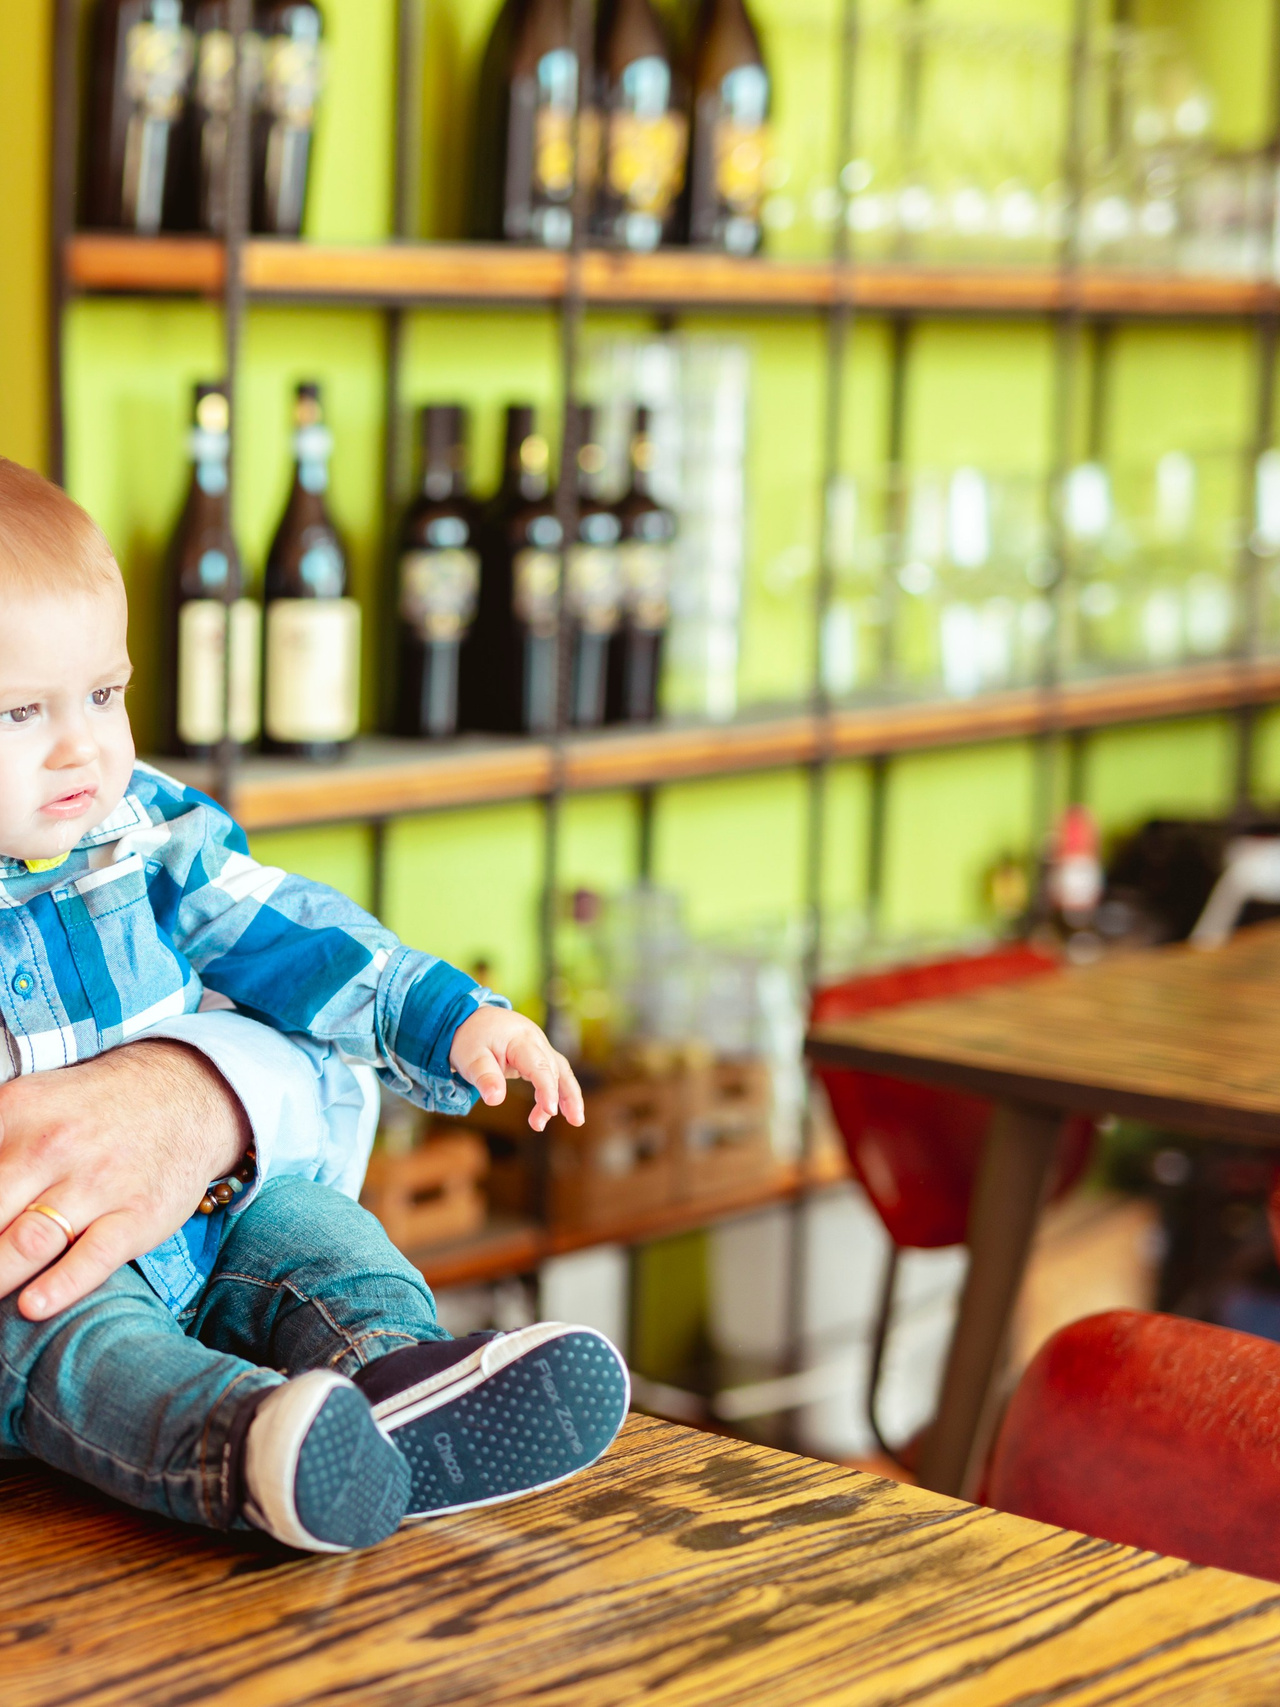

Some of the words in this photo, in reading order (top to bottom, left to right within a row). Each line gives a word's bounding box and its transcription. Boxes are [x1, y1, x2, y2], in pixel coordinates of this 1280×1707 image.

[532, 1358, 561, 1405] Flex
[554, 1404, 584, 1455] Zone
[433, 1431, 465, 1484] Chicco
